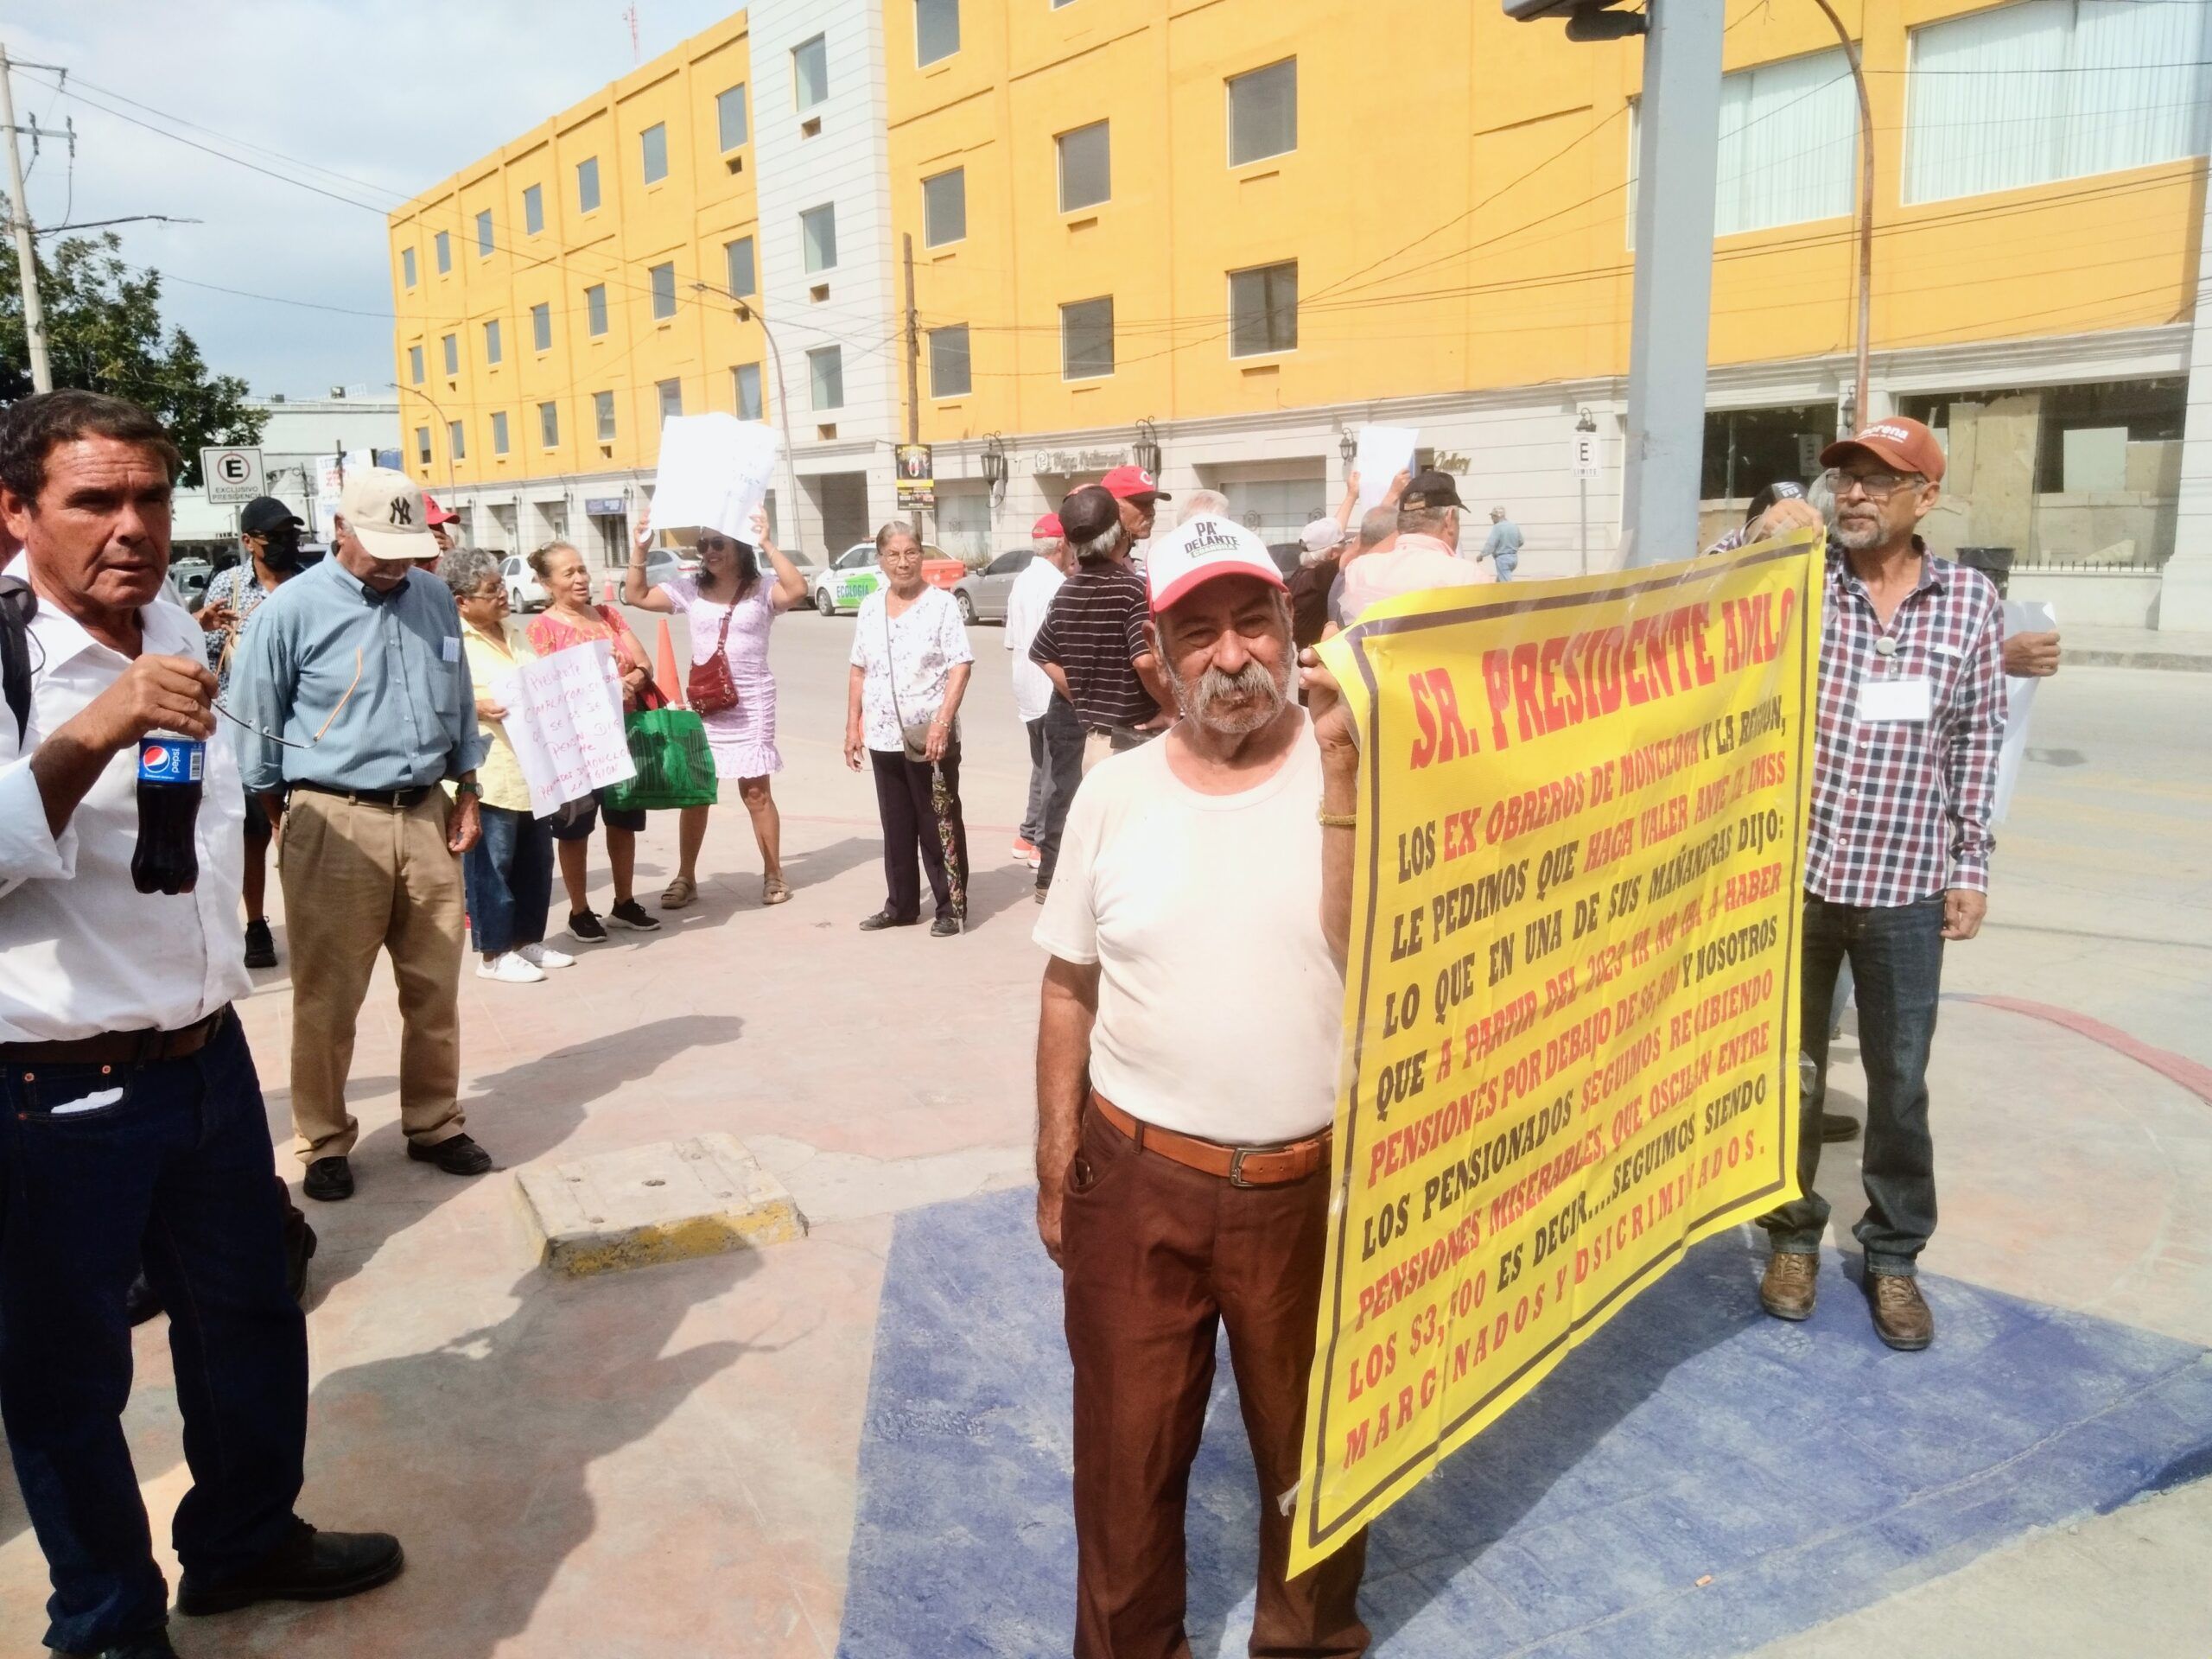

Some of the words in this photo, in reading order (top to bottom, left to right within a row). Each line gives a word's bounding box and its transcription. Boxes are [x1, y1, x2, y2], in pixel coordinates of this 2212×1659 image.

[226, 460, 244, 478] E
[1184, 535, 1240, 553] DELANTE
[1580, 442, 1589, 461] E
[1410, 667, 1480, 770] SR.
[1482, 601, 1717, 751] PRESIDENTE
[1390, 905, 1424, 963] LE
[1432, 857, 1530, 944] PEDIMOS
[1535, 839, 1580, 905] QUE
[1582, 817, 1634, 873] HAGA
[1640, 794, 1688, 849] VALER
[1694, 775, 1730, 824] ANTE
[1747, 751, 1786, 793] IMSS
[1397, 820, 1436, 884] LOS
[1443, 805, 1482, 864] EX
[1485, 781, 1585, 846] OBREROS
[1589, 770, 1615, 809] DE
[1619, 728, 1699, 797] MONCLOVA
[1702, 721, 1712, 760] Y
[1715, 715, 1734, 755] LA
[1376, 1049, 1428, 1120] QUE
[1435, 1039, 1452, 1084] A
[1462, 991, 1538, 1071] PARTIR
[1543, 965, 1578, 1018] DEL
[1585, 940, 1626, 994] 2023
[1630, 927, 1650, 968] YA
[1655, 912, 1677, 955] NO
[1707, 886, 1719, 920] A
[1725, 862, 1782, 912] HABER
[1382, 982, 1421, 1040] LO
[1434, 963, 1476, 1024] QUE
[1487, 930, 1516, 988] EN
[1524, 908, 1562, 967] UNA
[1572, 892, 1600, 941] DE
[1607, 874, 1642, 923] SUS
[1737, 808, 1783, 855] DIJO:
[1361, 1193, 1410, 1263] LOS
[1422, 1088, 1573, 1220] PENSIONADOS
[1580, 1026, 1661, 1115] SEGUIMOS
[1669, 969, 1773, 1052] RECIBIENDO
[1367, 1079, 1497, 1190] PENSIONES
[1500, 1052, 1541, 1110] POR
[1544, 1007, 1611, 1080] DEBAJO
[1615, 991, 1637, 1037] DE
[1683, 952, 1693, 988] Y
[1696, 914, 1777, 983] NOSOTROS
[1347, 1331, 1396, 1403] LOS
[1496, 1243, 1524, 1294] ES
[1704, 1072, 1766, 1136] SIENDO
[1354, 1209, 1481, 1332] PENSIONES
[1489, 1122, 1607, 1237] MISERABLES,
[1611, 1094, 1643, 1153] QUE
[1649, 1050, 1713, 1120] OSCILAN
[1717, 1020, 1770, 1076] ENTRE
[1556, 1264, 1567, 1303] Y
